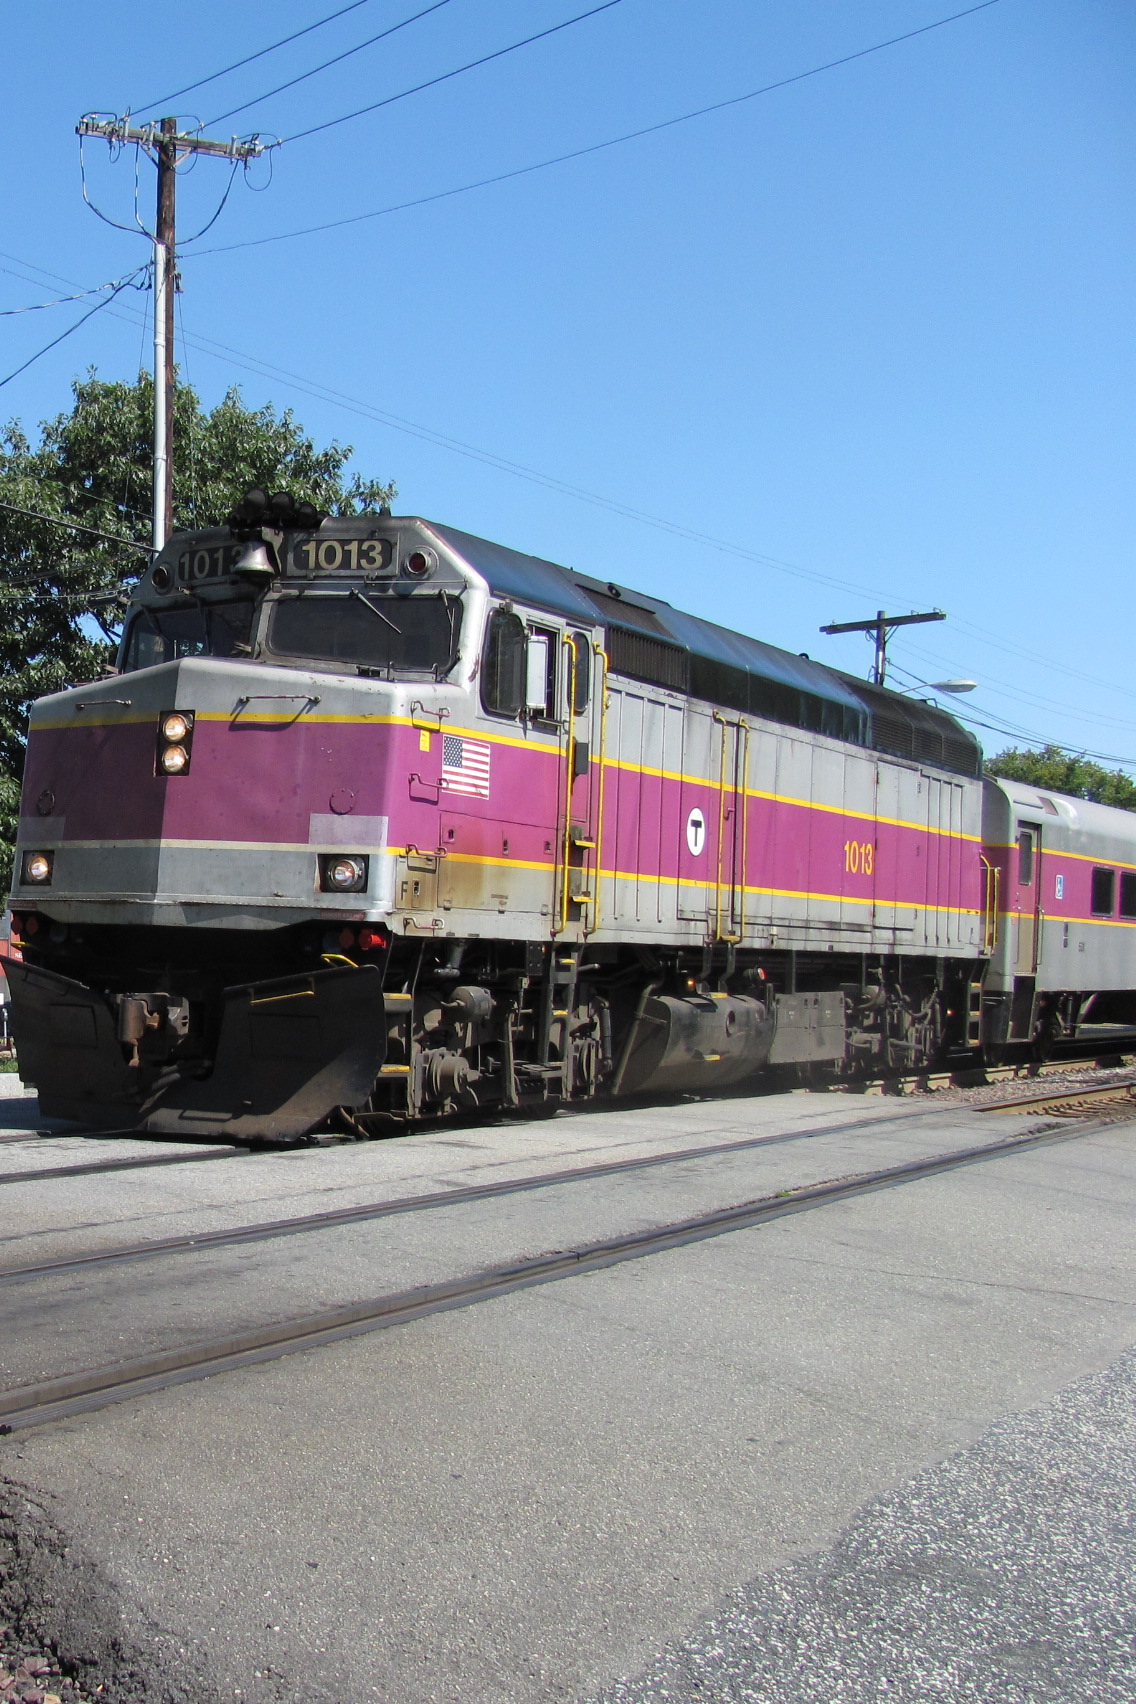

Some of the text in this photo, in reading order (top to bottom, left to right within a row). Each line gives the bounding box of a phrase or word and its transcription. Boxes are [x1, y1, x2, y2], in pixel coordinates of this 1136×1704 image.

[302, 540, 383, 570] 1013
[690, 818, 703, 848] T
[844, 840, 874, 875] 1013
[401, 881, 409, 900] F
